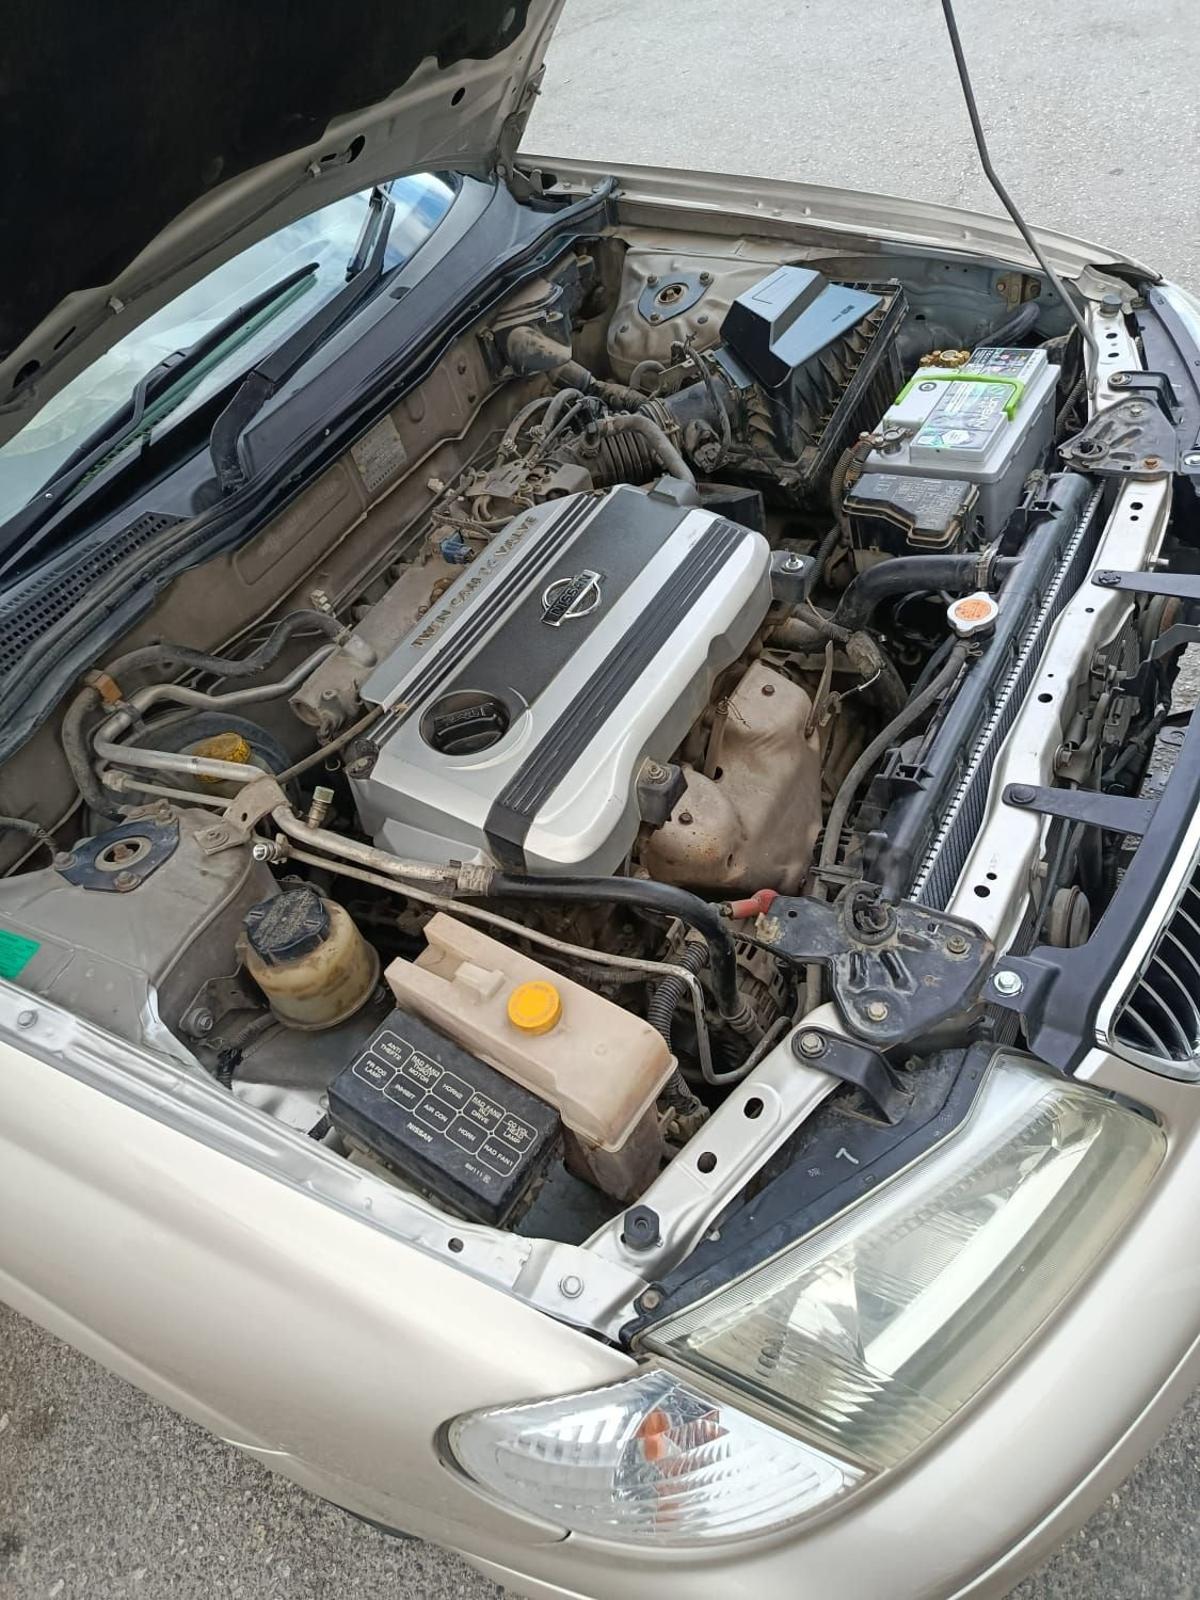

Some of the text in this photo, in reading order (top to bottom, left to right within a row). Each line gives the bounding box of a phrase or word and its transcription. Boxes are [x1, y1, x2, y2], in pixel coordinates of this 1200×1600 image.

[411, 609, 451, 649] TWIN
[495, 515, 536, 556] VALVE
[551, 573, 593, 618] NISSAN
[386, 1041, 402, 1054] ANTI
[364, 1065, 381, 1079] LAMP
[373, 1065, 387, 1077] FOG
[407, 1066, 429, 1083] MOTOR
[472, 1096, 486, 1108] RAD
[422, 1103, 448, 1122] AIR CON
[470, 1109, 489, 1124] DRIVE
[407, 1122, 433, 1143] NISSAN
[457, 1126, 476, 1141] HORN
[502, 1130, 521, 1145] LAMP
[483, 1144, 497, 1156] RAD
